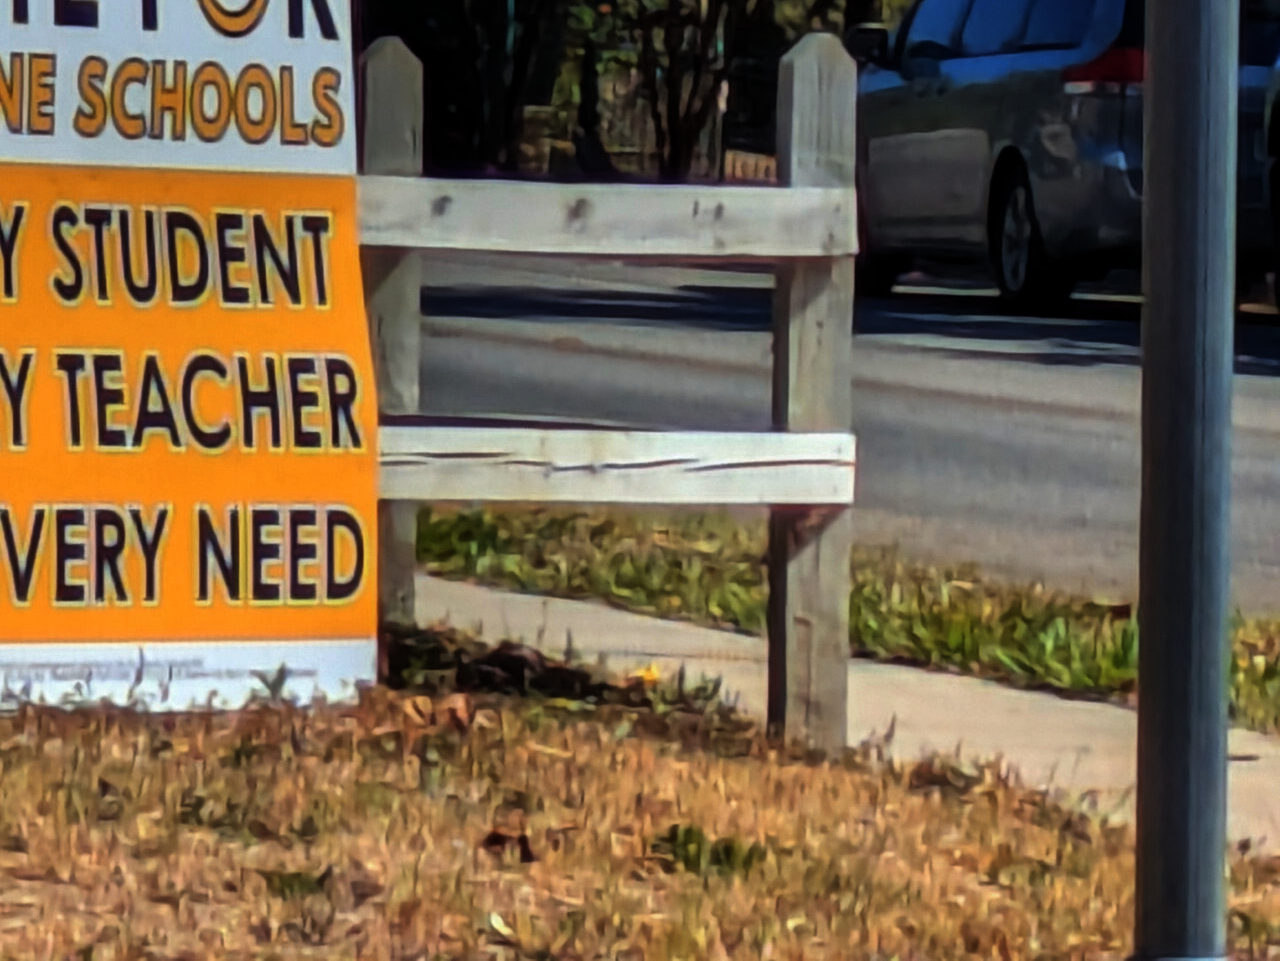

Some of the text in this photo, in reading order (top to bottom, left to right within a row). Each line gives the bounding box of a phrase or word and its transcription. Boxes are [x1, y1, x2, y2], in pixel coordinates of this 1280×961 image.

[73, 55, 345, 148] SCHOOLS
[51, 205, 331, 307] STUDENT
[56, 352, 363, 450] TEACHER
[198, 509, 364, 604] NEED
